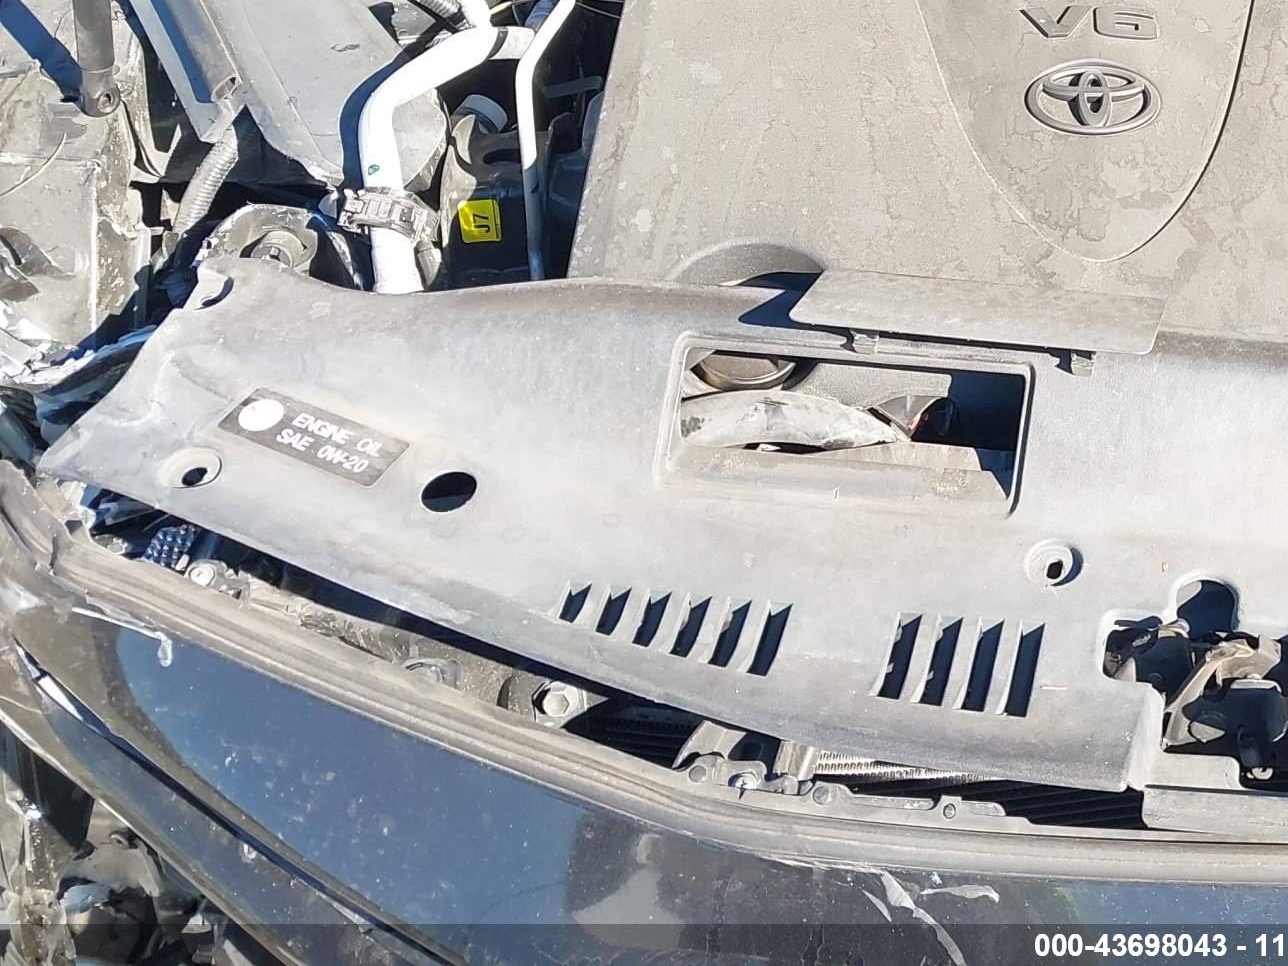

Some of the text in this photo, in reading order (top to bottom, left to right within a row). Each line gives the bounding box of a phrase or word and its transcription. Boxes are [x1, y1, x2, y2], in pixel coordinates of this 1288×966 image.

[1018, 5, 1159, 41] V6
[276, 428, 369, 473] SAE 0W-20
[292, 412, 384, 457] ENGINE OIL
